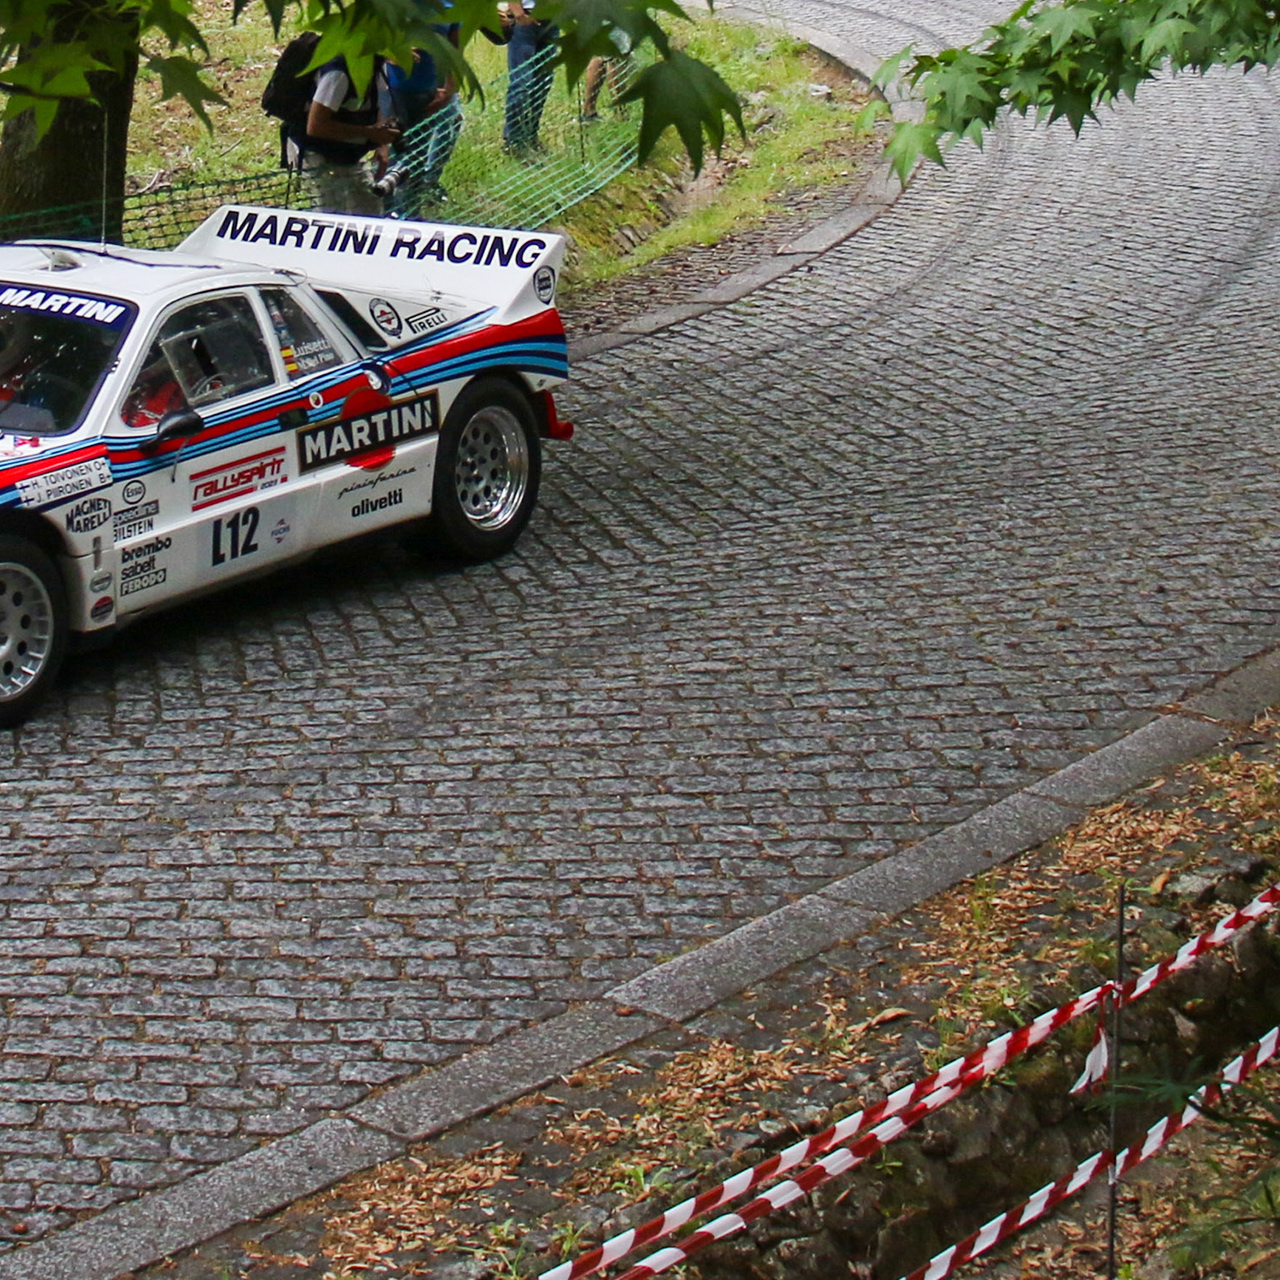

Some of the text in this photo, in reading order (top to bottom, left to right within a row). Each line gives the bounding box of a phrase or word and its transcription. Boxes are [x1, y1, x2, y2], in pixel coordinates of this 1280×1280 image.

[216, 210, 548, 270] MARTINI RACING
[404, 307, 448, 334] PIRELLI
[303, 399, 433, 465] MARTINI
[43, 462, 93, 486] TOIVONEN
[351, 488, 404, 518] olivetti
[121, 536, 172, 564] brembo
[211, 506, 261, 567] L12
[121, 554, 157, 581] sabelt
[122, 570, 166, 596] FERODO
